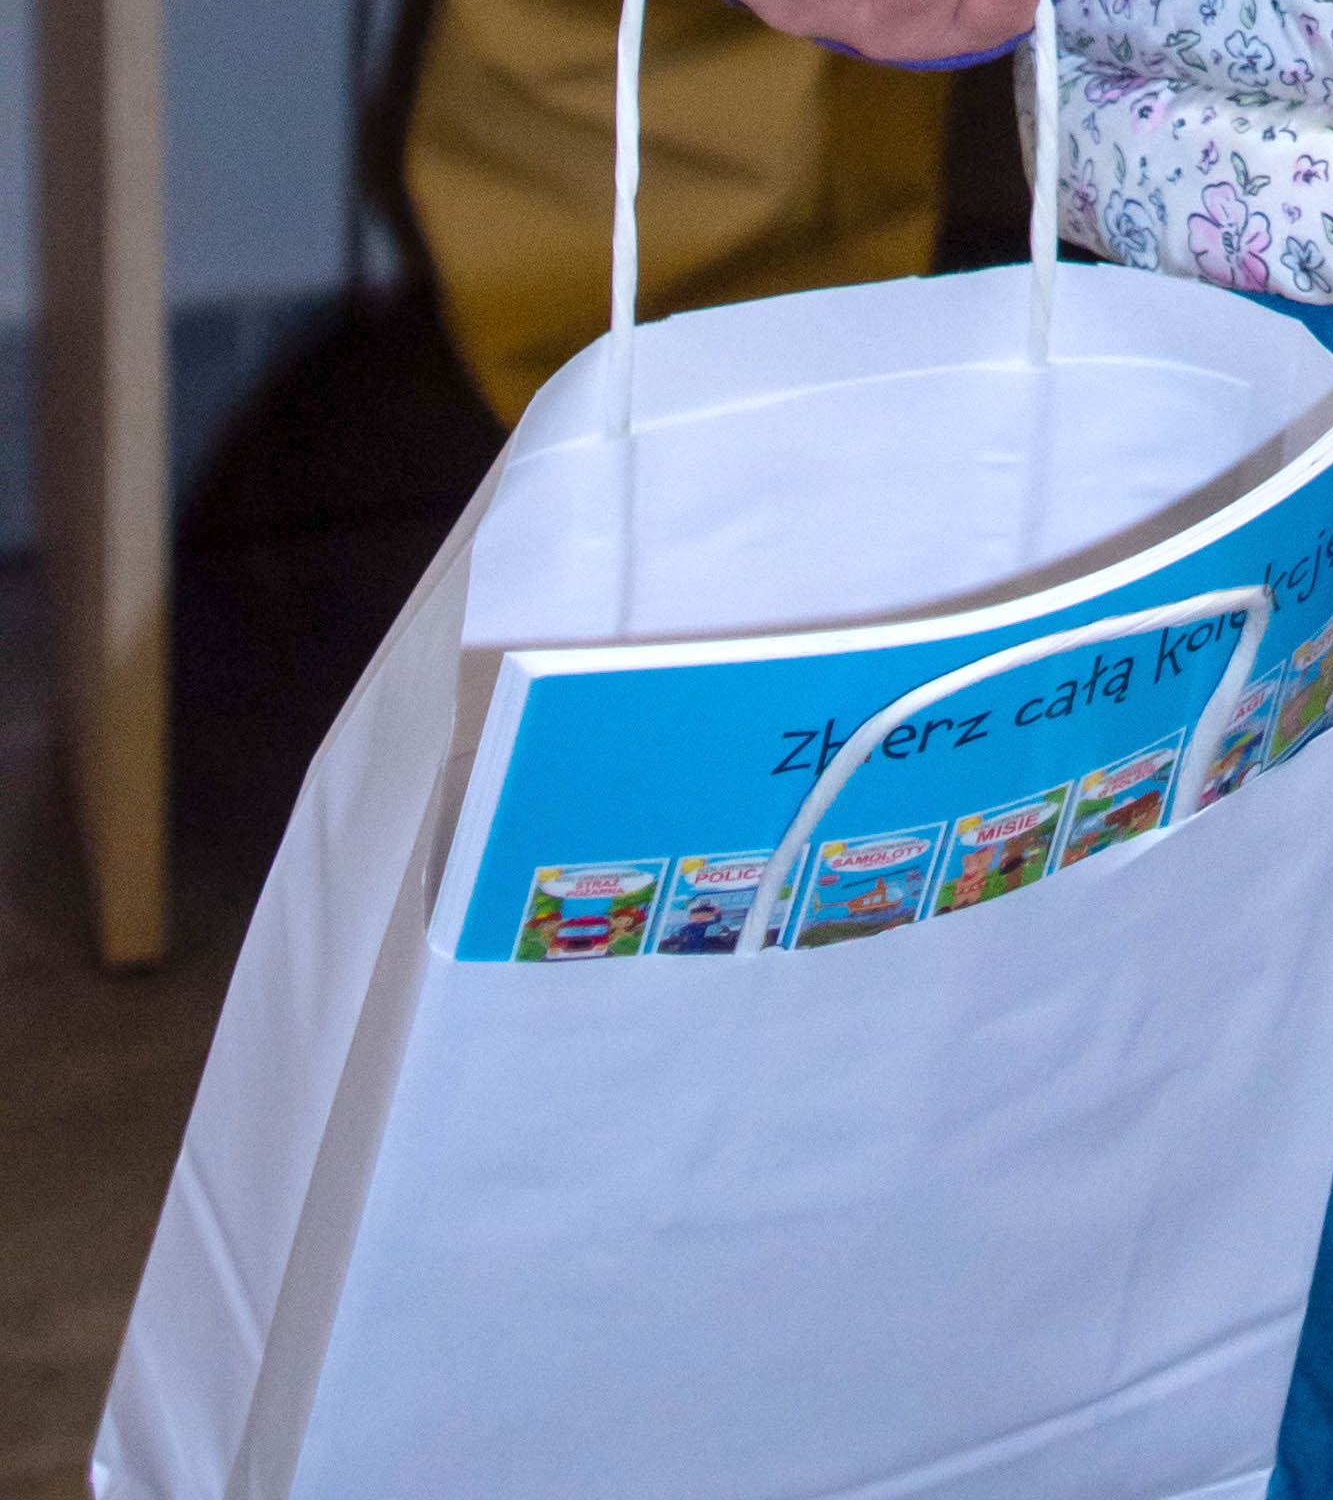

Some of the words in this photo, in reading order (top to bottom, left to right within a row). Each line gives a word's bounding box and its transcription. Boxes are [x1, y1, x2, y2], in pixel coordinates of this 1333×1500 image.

[771, 711, 992, 776] Zberz
[1014, 654, 1134, 727] całą
[976, 812, 1040, 844] MISIE
[694, 866, 766, 885] POLIC
